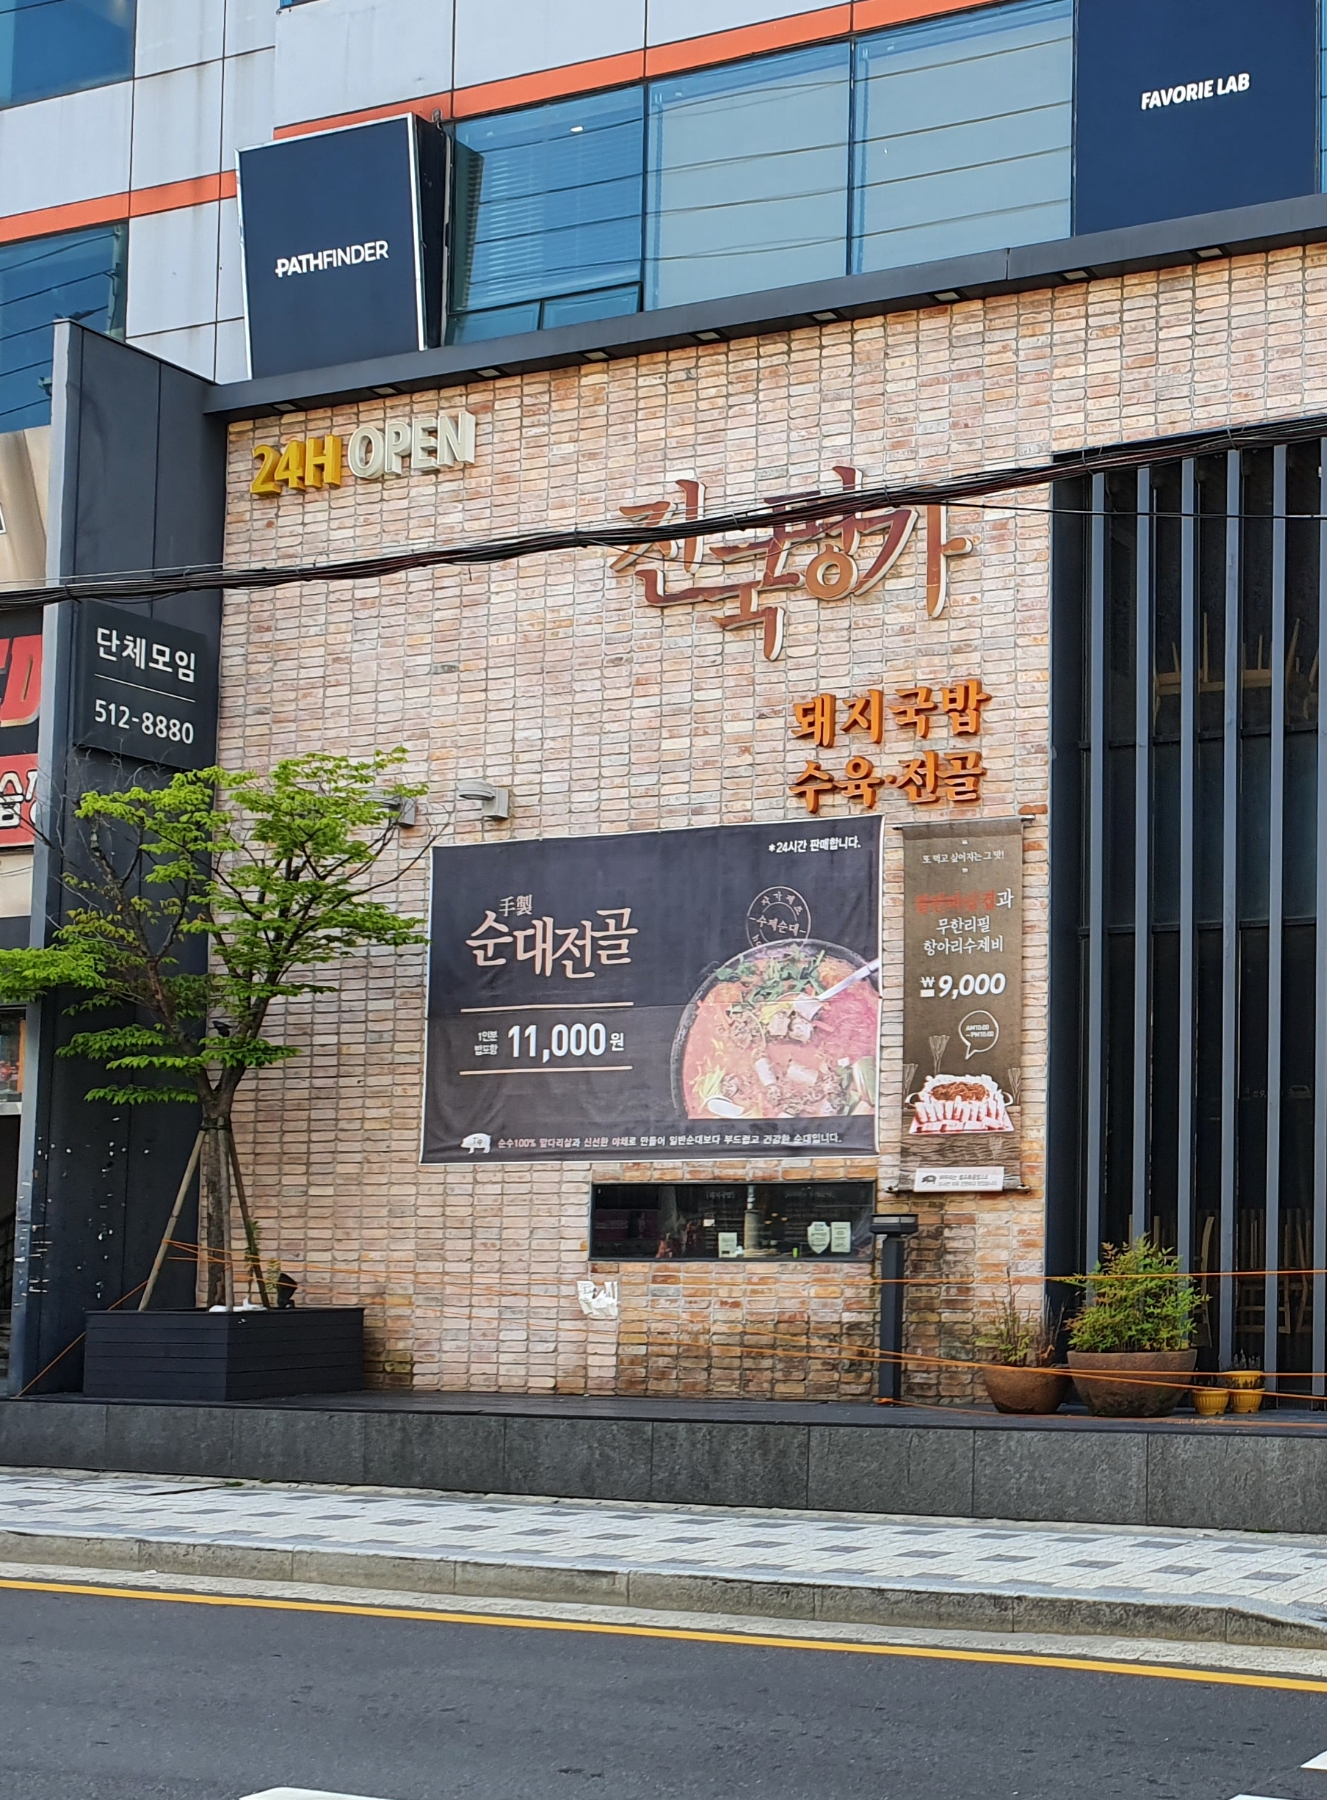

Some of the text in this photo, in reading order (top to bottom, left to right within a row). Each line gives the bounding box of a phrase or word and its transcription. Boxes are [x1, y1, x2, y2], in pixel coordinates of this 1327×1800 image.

[1141, 73, 1250, 110] FAVORIE LAB
[275, 240, 389, 277] PATHFINDER
[251, 411, 476, 496] 24H OPEN
[610, 466, 973, 661] 진국명가
[97, 627, 195, 683] 단체모임
[95, 699, 194, 744] 512-8880
[792, 679, 992, 748] 돼지국밥
[465, 908, 639, 979] 순대전골
[923, 935, 1003, 956] 항아리수제비
[936, 915, 991, 935] 무한리필
[508, 1022, 624, 1063] 11,000 원
